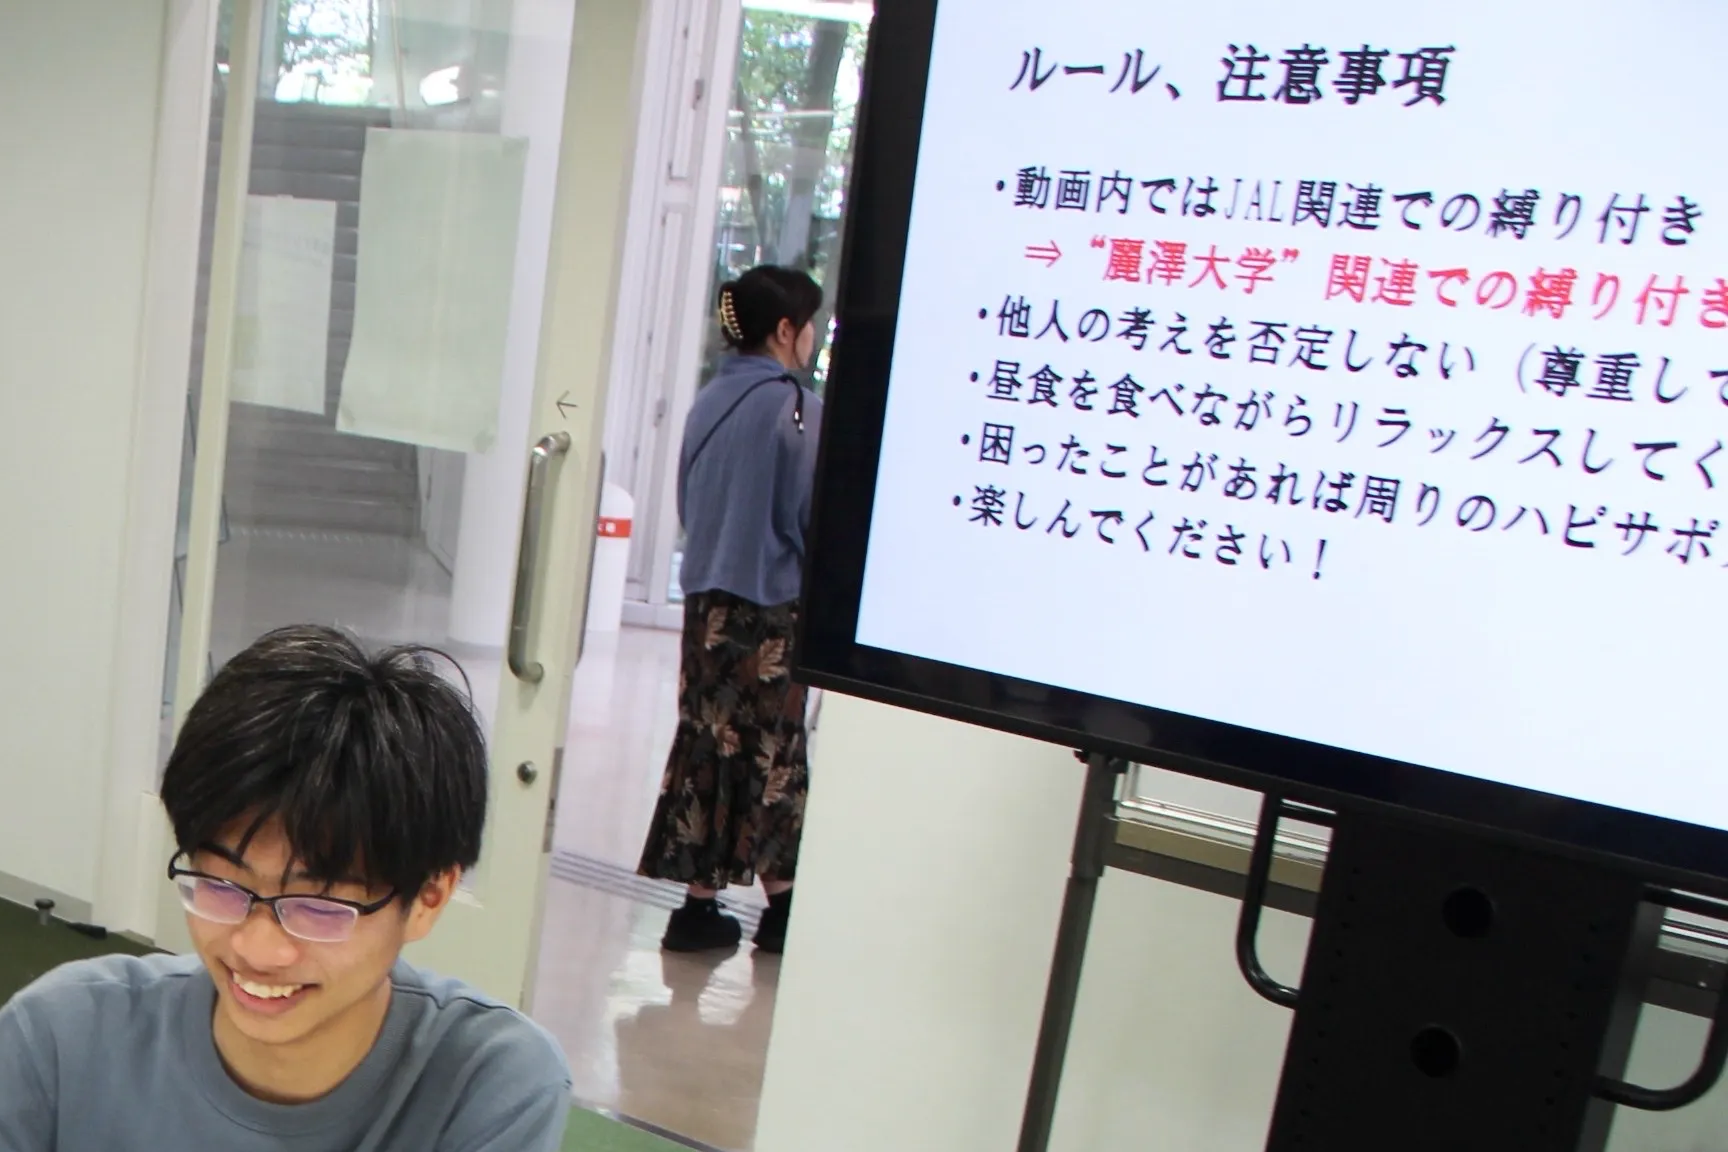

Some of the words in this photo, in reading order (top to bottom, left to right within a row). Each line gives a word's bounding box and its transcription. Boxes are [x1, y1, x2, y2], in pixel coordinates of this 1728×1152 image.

[1010, 43, 1457, 107] ルール、注意事項
[960, 421, 1728, 568] ・困ったことがあれば周りのハピサポ
